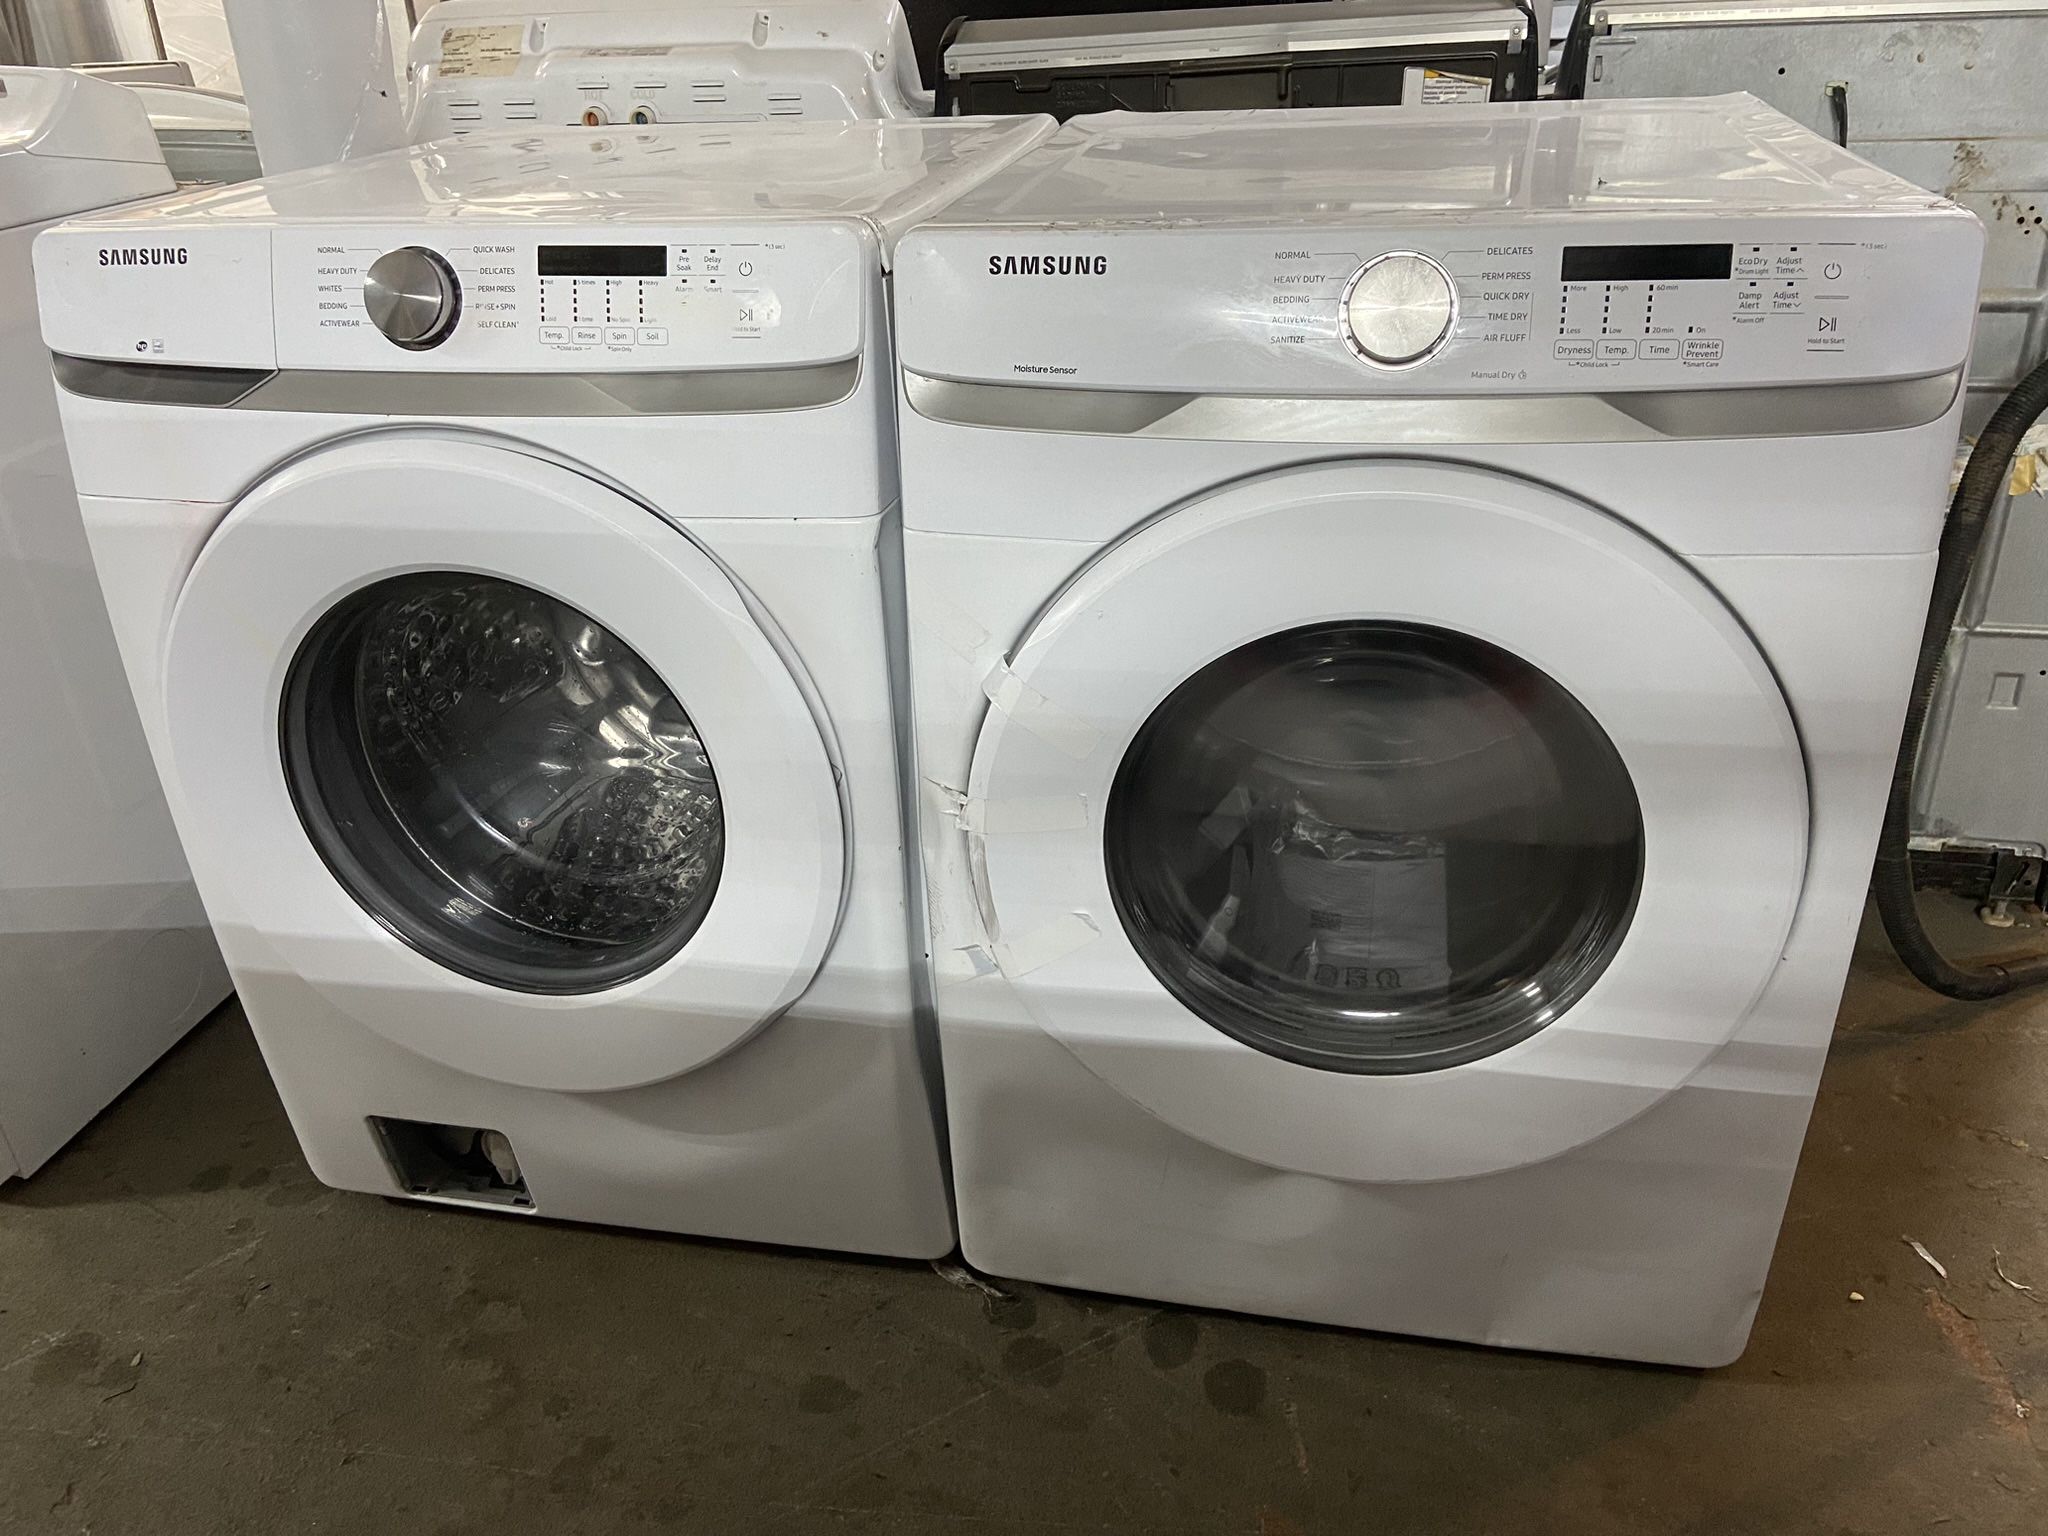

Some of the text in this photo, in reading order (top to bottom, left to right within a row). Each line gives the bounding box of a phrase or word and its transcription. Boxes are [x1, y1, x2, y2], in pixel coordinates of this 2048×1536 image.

[317, 246, 345, 254] NORMAL
[473, 246, 515, 254] QUICK WASH
[1487, 246, 1534, 255] DELICATES
[99, 247, 188, 266] SAMSUNG
[1274, 251, 1311, 259] NORMAL
[704, 256, 722, 264] Delay
[1738, 257, 1769, 267] Eco Dry
[1776, 256, 1803, 266] Adjust
[989, 255, 1108, 276] SAMSUNG
[480, 267, 515, 275] DELICATES
[1775, 266, 1795, 275] Time
[1273, 274, 1326, 284] HEAVY DUTY
[1481, 271, 1531, 281] PERM PRESS
[478, 285, 516, 293] PERM PRESS
[1571, 284, 1587, 292] More
[1613, 284, 1629, 293] High
[1272, 295, 1310, 304] BEDDING
[1483, 291, 1530, 301] QUICK DRY
[1738, 292, 1762, 302] Damp
[1773, 291, 1800, 301] Adjust
[319, 302, 348, 310] BEDDING
[1739, 301, 1760, 310] Alert
[1773, 301, 1792, 309] Time
[1488, 312, 1528, 321] TIME DRY
[1696, 326, 1706, 334] On
[544, 332, 564, 340] Temp.
[612, 332, 627, 341] Spin
[646, 332, 659, 341] Soil
[1270, 335, 1305, 344] SANITIZE
[1483, 333, 1527, 342] AIR FLUFF
[1649, 345, 1670, 355] Time
[1687, 340, 1720, 351] Wrinkle
[1557, 345, 1592, 356] Dryness
[1604, 345, 1629, 356] Temp.
[1686, 350, 1719, 359] Prevent
[1014, 364, 1078, 375] Moisture Sensor
[1471, 370, 1516, 381] Manual Dry
